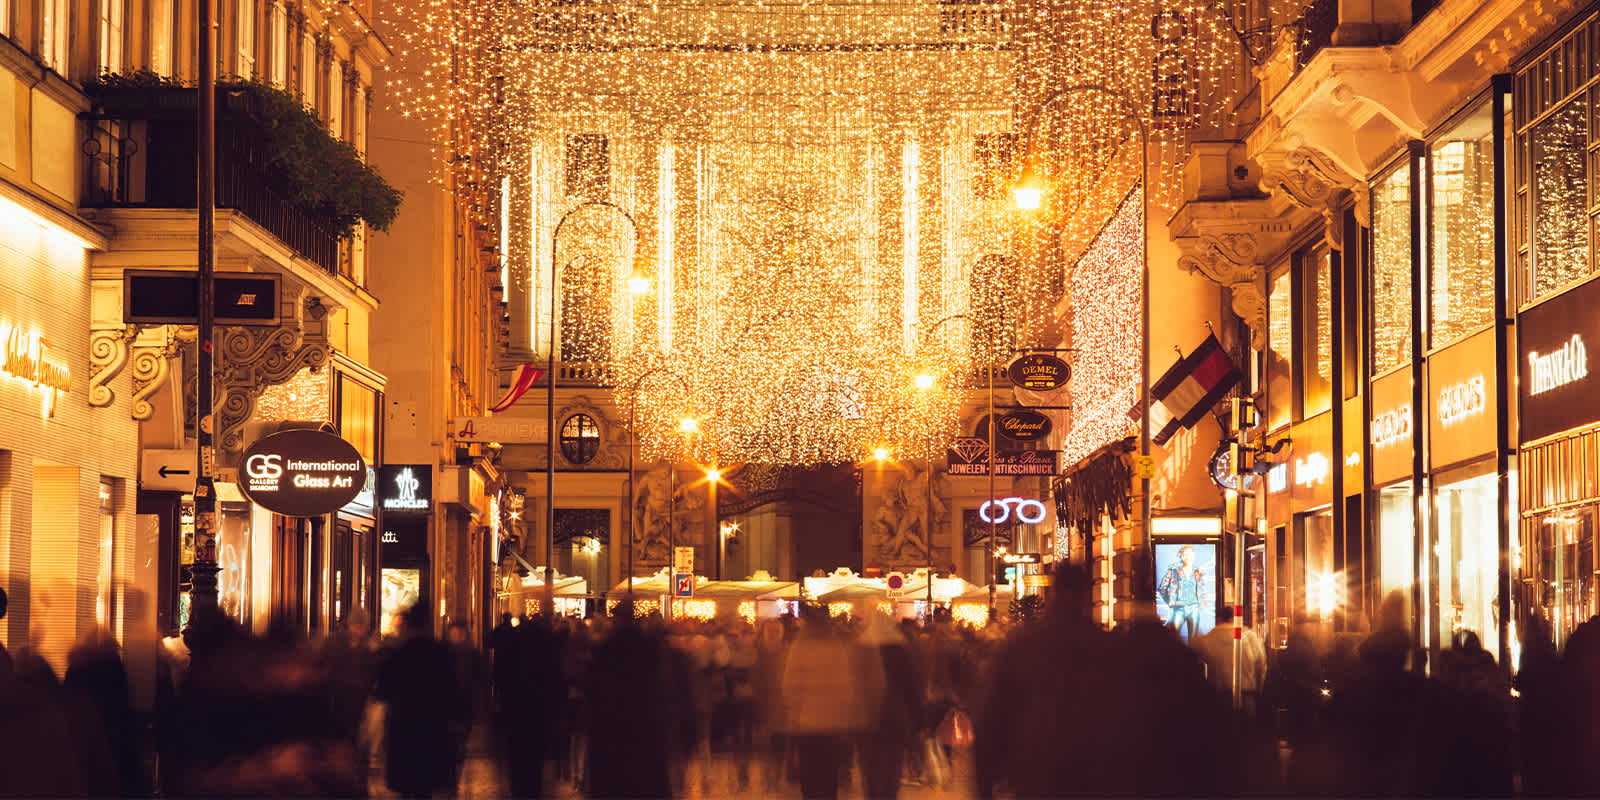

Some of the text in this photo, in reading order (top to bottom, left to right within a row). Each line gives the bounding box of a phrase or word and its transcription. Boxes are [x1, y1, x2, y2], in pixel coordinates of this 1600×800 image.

[1022, 365, 1059, 376] DEMEL
[246, 454, 282, 479] GS
[287, 459, 360, 472] International
[948, 463, 1054, 475] JUWELEN NTIKSCHMUCK
[293, 474, 330, 488] Glass
[332, 475, 353, 488] Art
[384, 499, 429, 509] MONCLER
